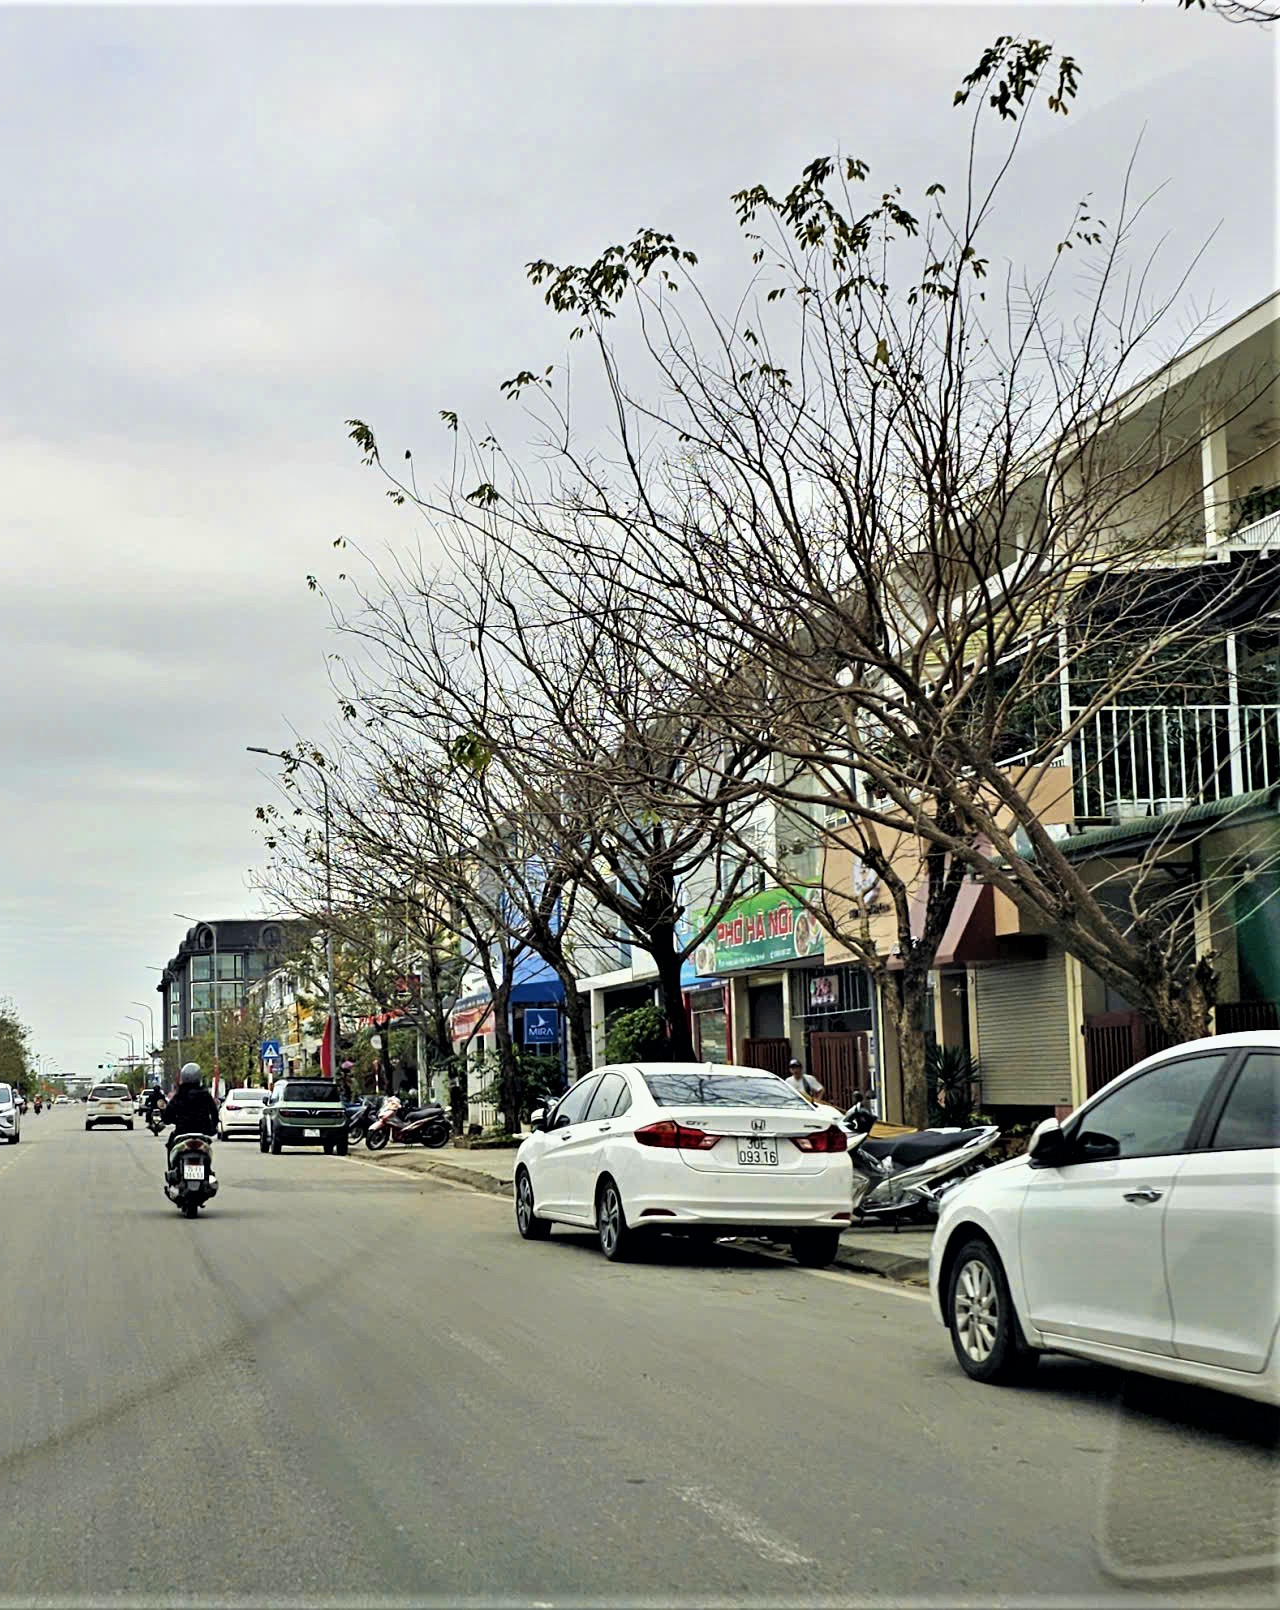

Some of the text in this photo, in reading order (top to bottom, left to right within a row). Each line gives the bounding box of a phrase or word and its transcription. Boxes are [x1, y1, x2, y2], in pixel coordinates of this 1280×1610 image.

[716, 900, 794, 949] PHỞ HÀ NỘI
[529, 1028, 554, 1036] MIRA
